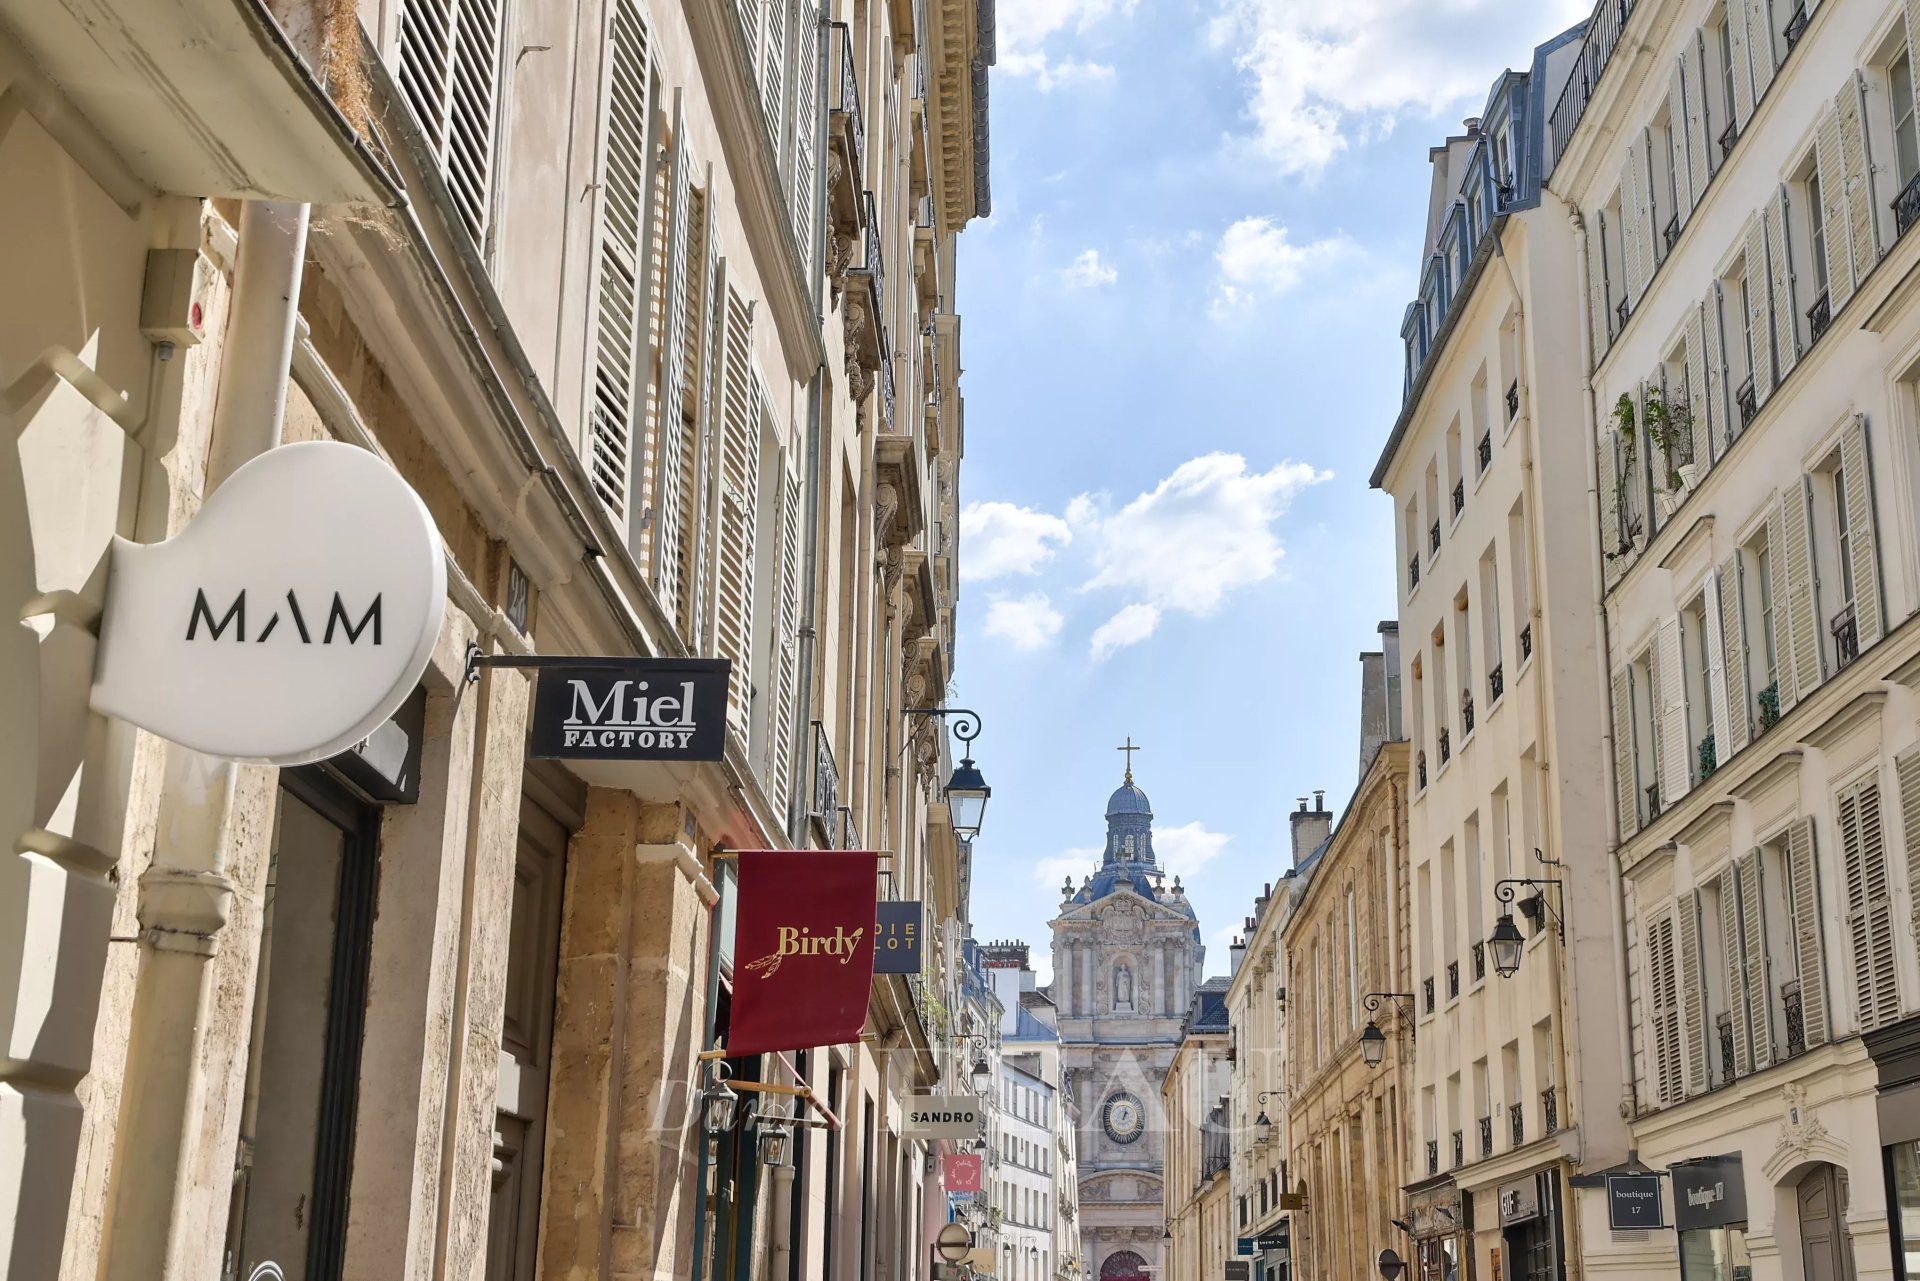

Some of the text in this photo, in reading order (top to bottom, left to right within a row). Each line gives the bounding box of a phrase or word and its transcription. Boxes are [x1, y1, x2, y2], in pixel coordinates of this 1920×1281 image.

[508, 567, 527, 628] 28
[185, 586, 382, 646] MAM
[563, 679, 697, 727] Miel
[563, 730, 694, 749] FACTORY
[777, 926, 864, 965] Birdy
[910, 1111, 974, 1123] SANDRO
[1615, 1190, 1654, 1200] boutique
[1687, 1185, 1716, 1210] boutique
[1631, 1206, 1641, 1214] 17
